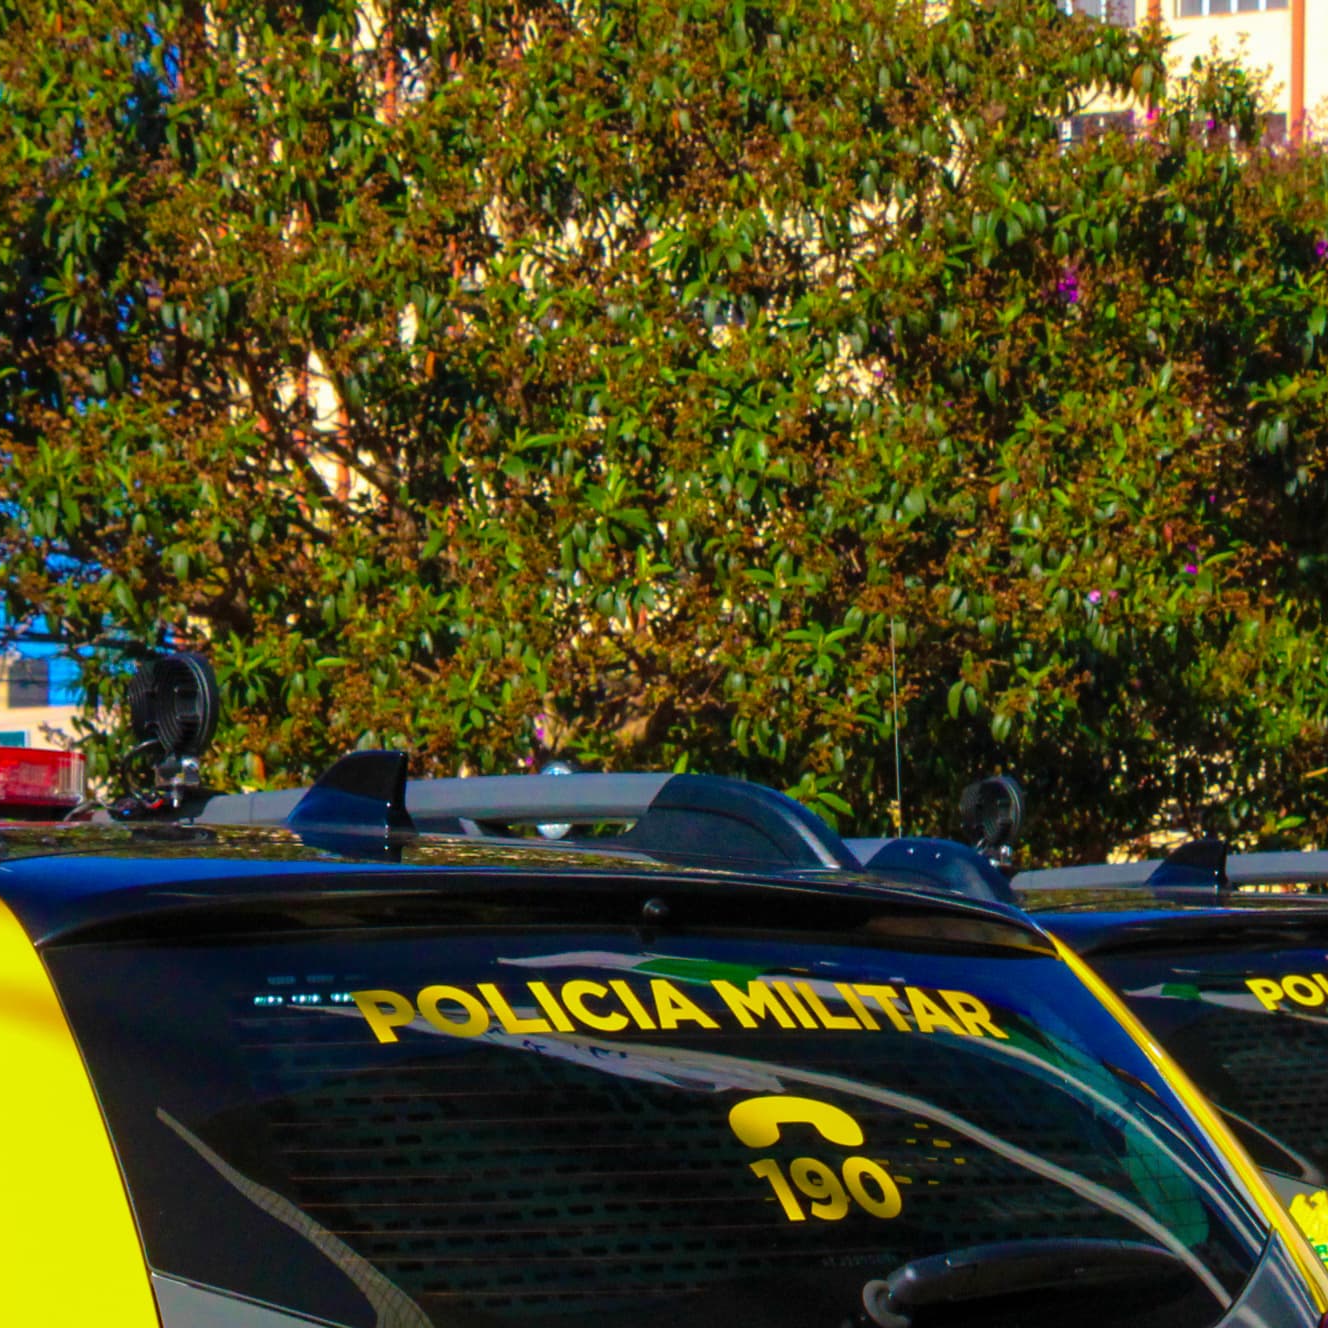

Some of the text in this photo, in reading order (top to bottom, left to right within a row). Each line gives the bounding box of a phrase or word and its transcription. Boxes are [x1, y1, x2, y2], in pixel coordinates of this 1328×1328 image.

[350, 979, 1010, 1044] POLICIA MILITAR
[749, 1156, 902, 1222] 190
